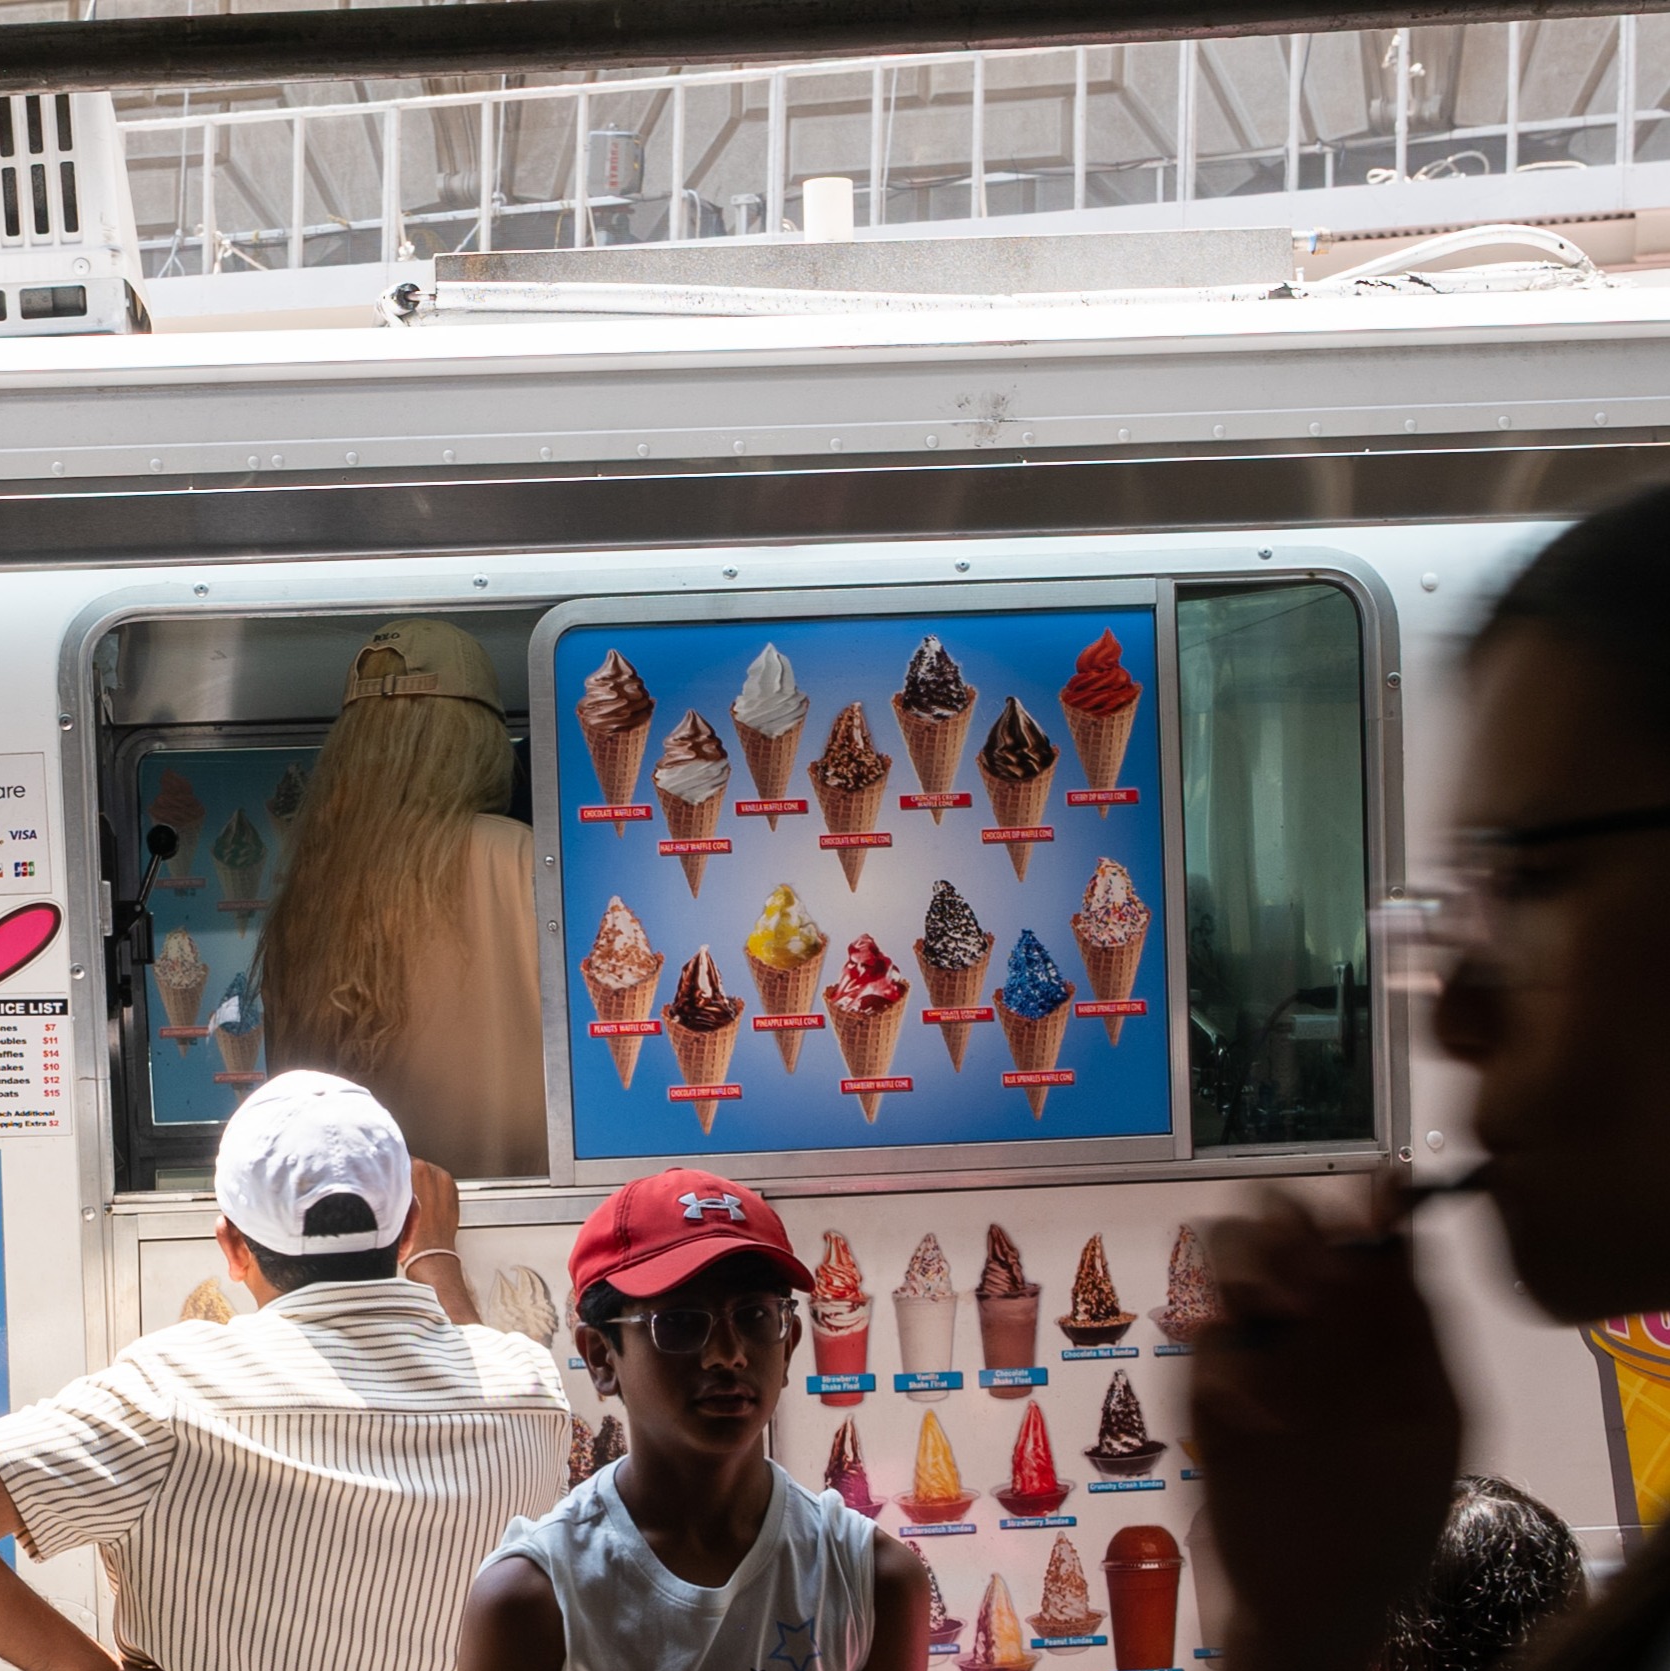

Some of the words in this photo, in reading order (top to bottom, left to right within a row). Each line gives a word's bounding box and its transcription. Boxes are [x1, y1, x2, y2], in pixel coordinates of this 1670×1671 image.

[741, 803, 762, 812] VANILLA
[783, 802, 800, 811] CONE
[633, 808, 646, 816] CONE
[8, 829, 37, 841] VISA
[713, 842, 729, 850] CONE
[29, 1002, 63, 1014] LIST
[803, 1017, 818, 1025] CONE
[45, 1024, 56, 1032] $7
[640, 1023, 655, 1031] CONE
[42, 1037, 58, 1045] $11
[43, 1050, 59, 1058] $14
[43, 1063, 60, 1071] $10
[43, 1076, 60, 1084] $12
